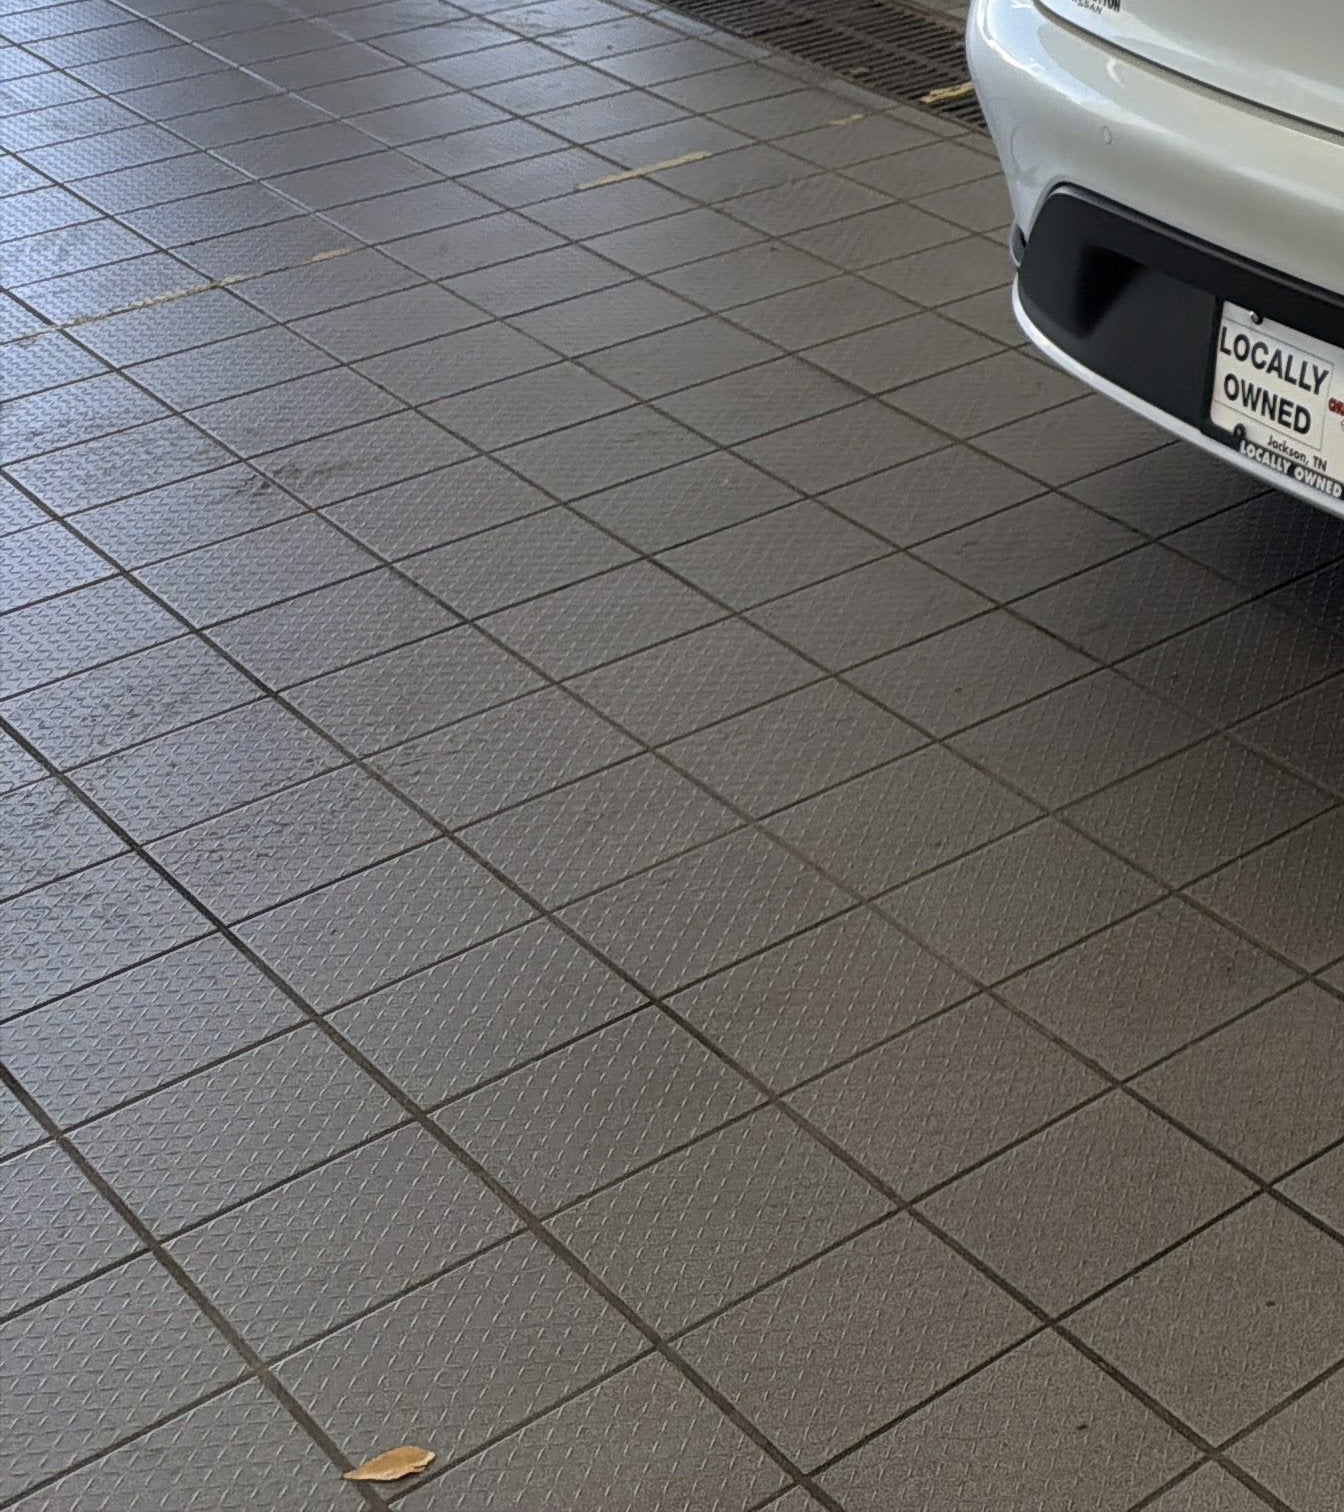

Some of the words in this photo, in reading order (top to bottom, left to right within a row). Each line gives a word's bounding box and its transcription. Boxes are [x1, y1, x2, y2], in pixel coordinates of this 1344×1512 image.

[1220, 326, 1329, 395] LOCALLY
[1224, 373, 1311, 435] OWNED
[1240, 440, 1291, 474] LOCALLY
[1294, 466, 1342, 498] OWNED
[1267, 435, 1309, 466] Jackson,
[1312, 455, 1328, 472] TN
